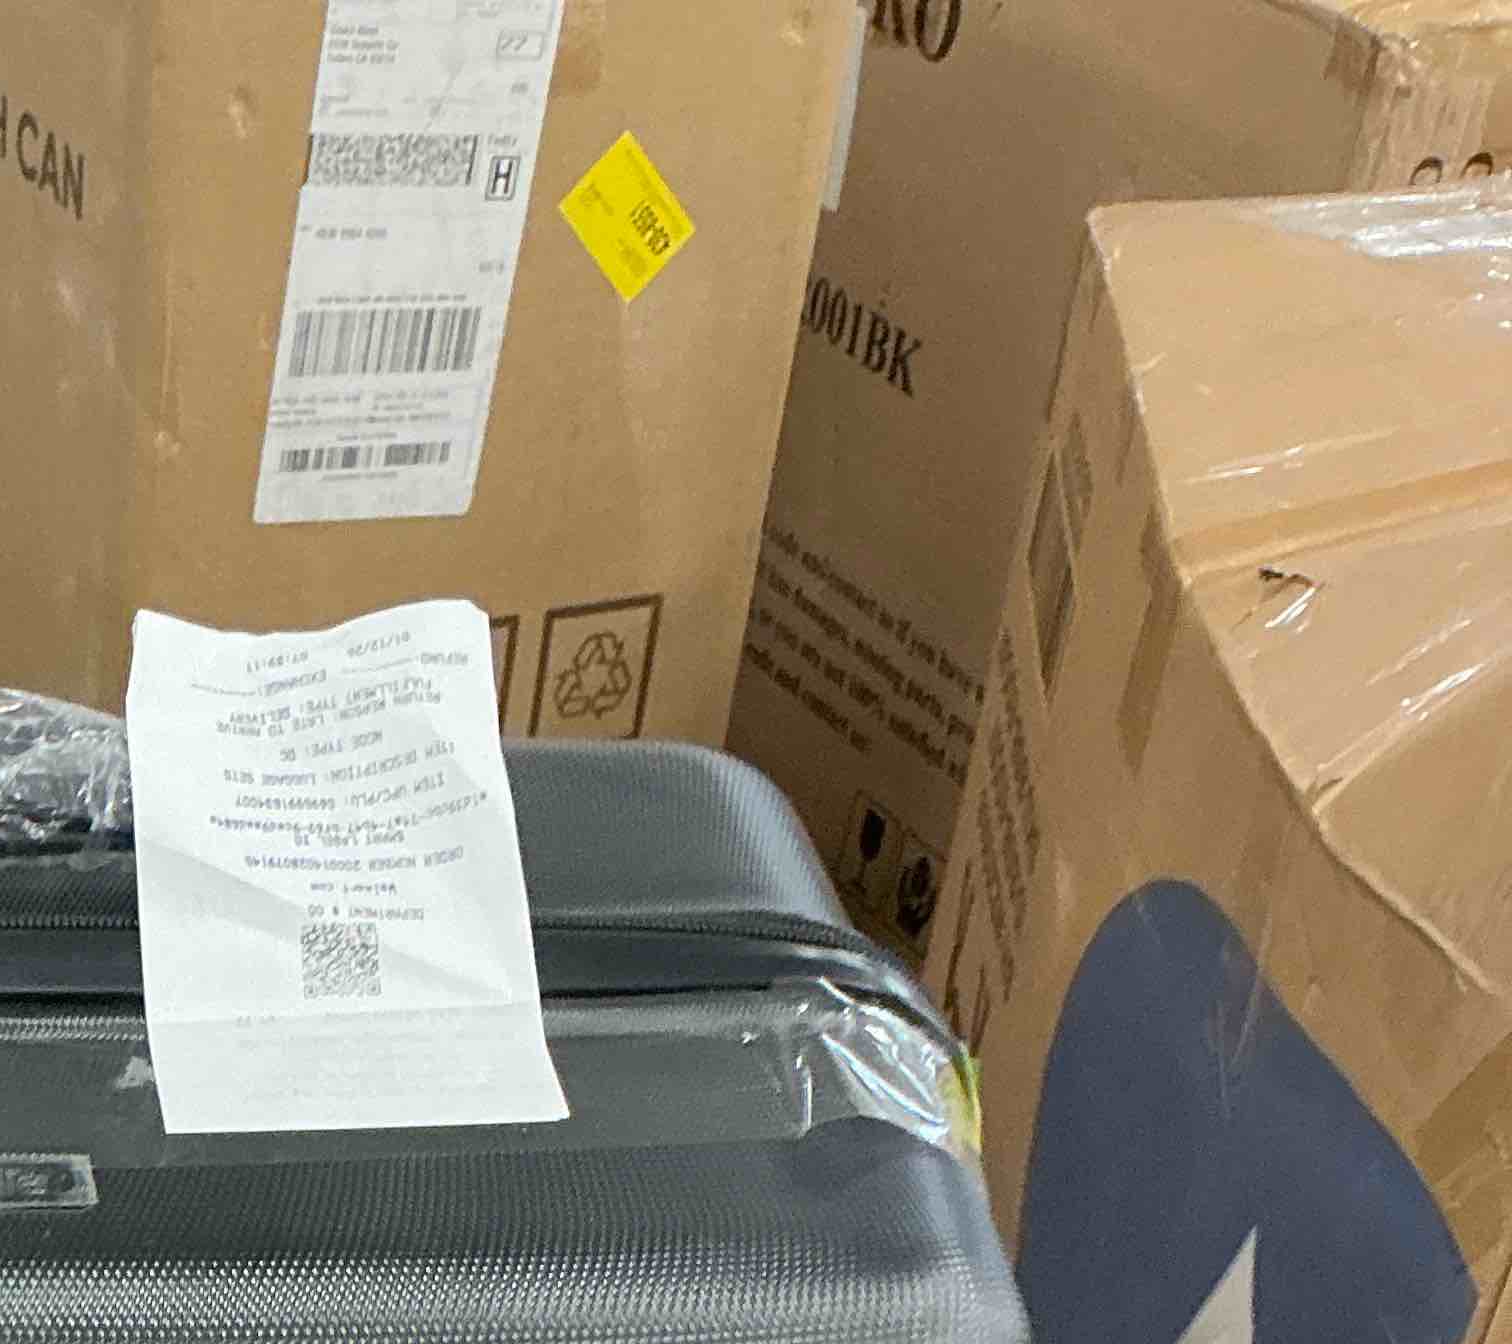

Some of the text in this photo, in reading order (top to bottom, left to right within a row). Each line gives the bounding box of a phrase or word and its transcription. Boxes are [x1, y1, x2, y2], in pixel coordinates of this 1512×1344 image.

[15, 108, 86, 222] CAN
[490, 159, 514, 195] H
[801, 276, 923, 398] 001BK
